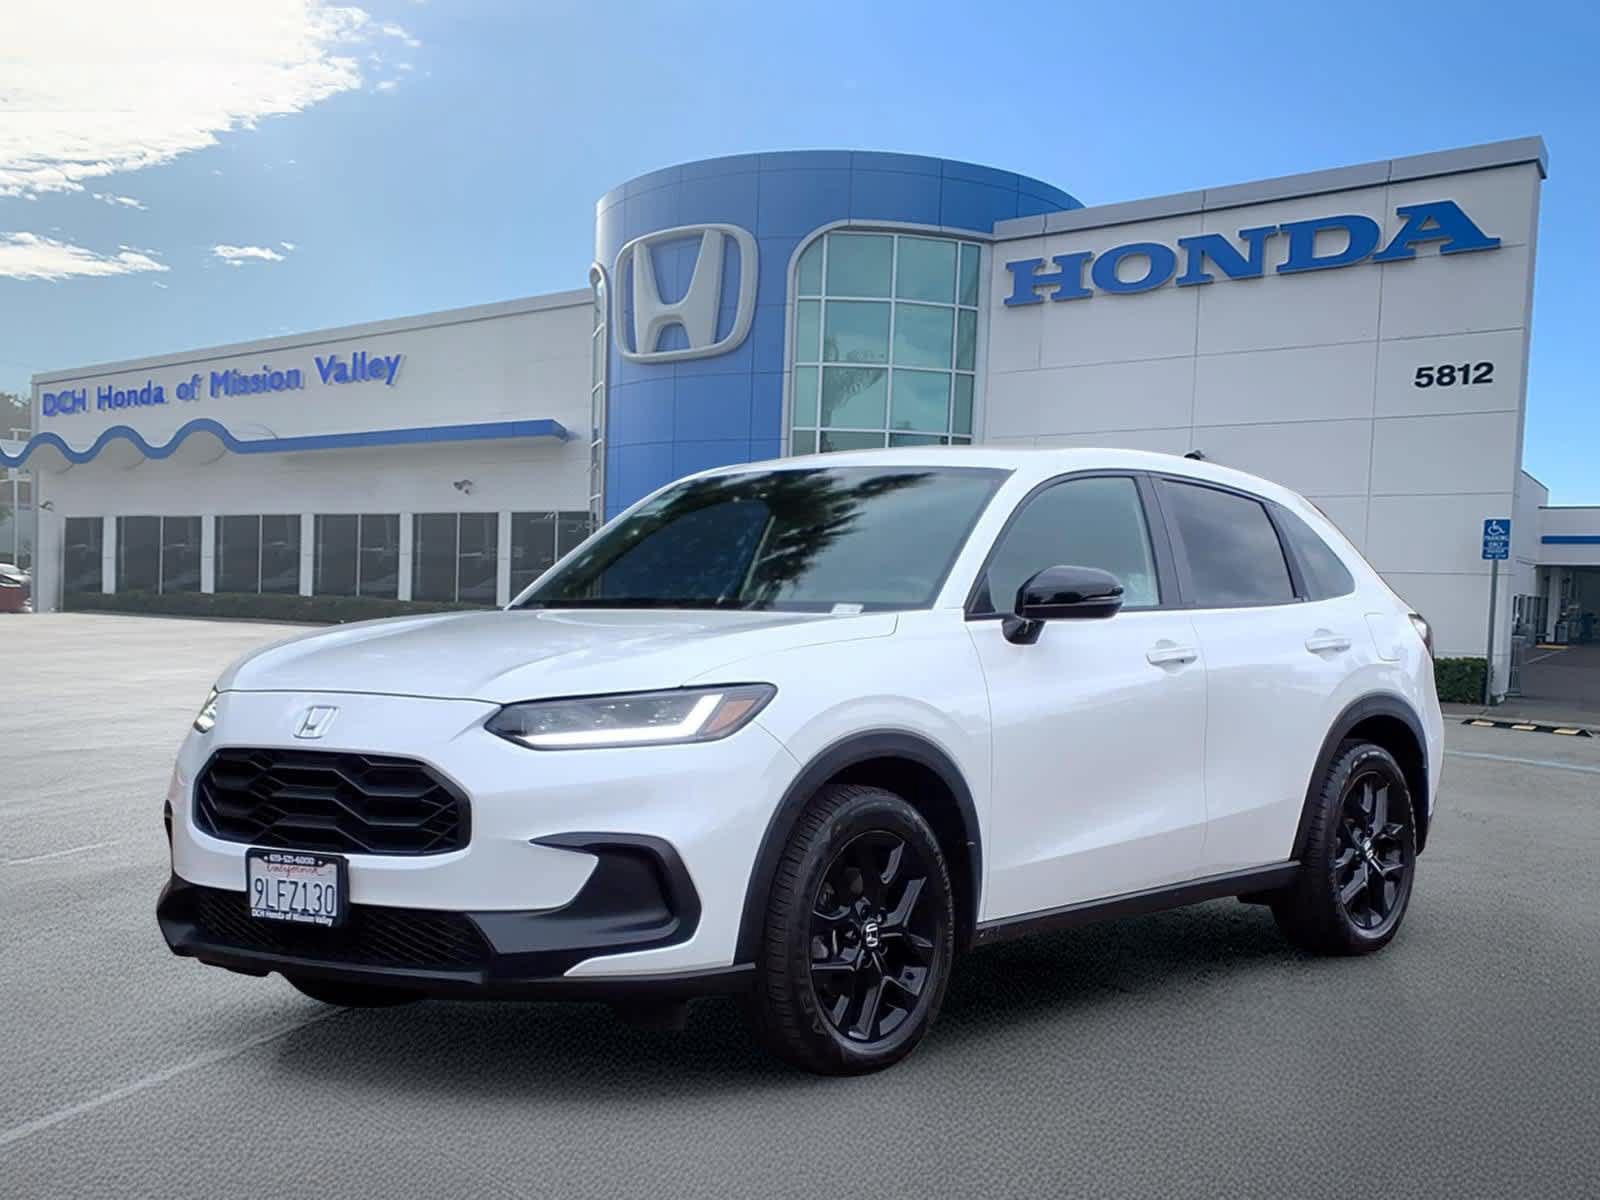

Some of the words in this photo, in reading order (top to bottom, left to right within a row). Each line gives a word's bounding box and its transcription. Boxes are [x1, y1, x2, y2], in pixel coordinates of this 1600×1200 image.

[1004, 199, 1501, 307] HONDA
[42, 388, 87, 417] DCH
[97, 380, 166, 411] Honda
[175, 374, 202, 402] of
[210, 365, 302, 399] Mission
[314, 351, 403, 388] Valley
[1413, 361, 1495, 389] 5812
[254, 877, 335, 914] 9LFZ130
